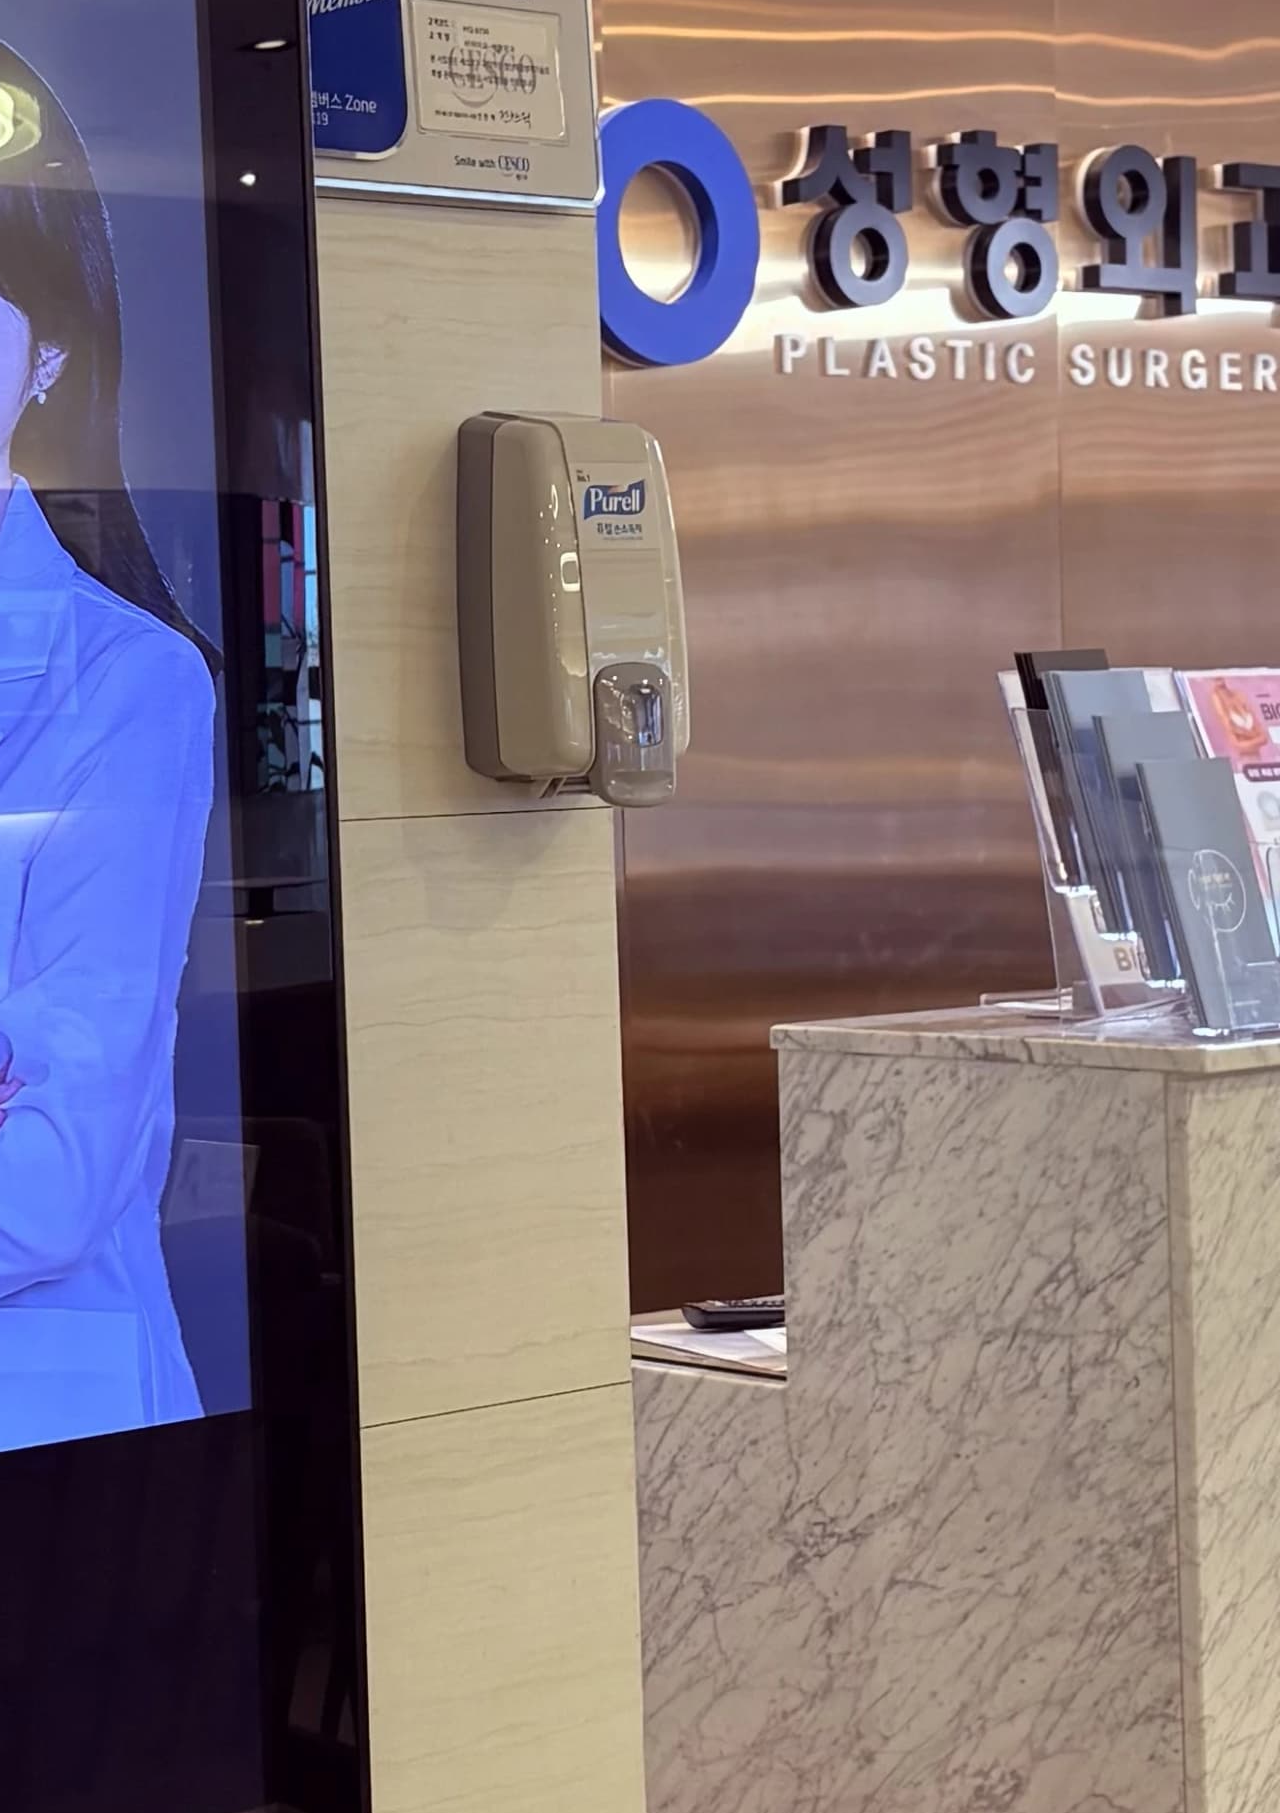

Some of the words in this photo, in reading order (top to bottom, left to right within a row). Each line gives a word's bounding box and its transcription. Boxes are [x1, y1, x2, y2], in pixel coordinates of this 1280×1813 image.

[345, 94, 377, 114] Zone
[597, 98, 760, 365] O
[776, 334, 1036, 384] PLASTIC
[589, 488, 640, 512] Purell
